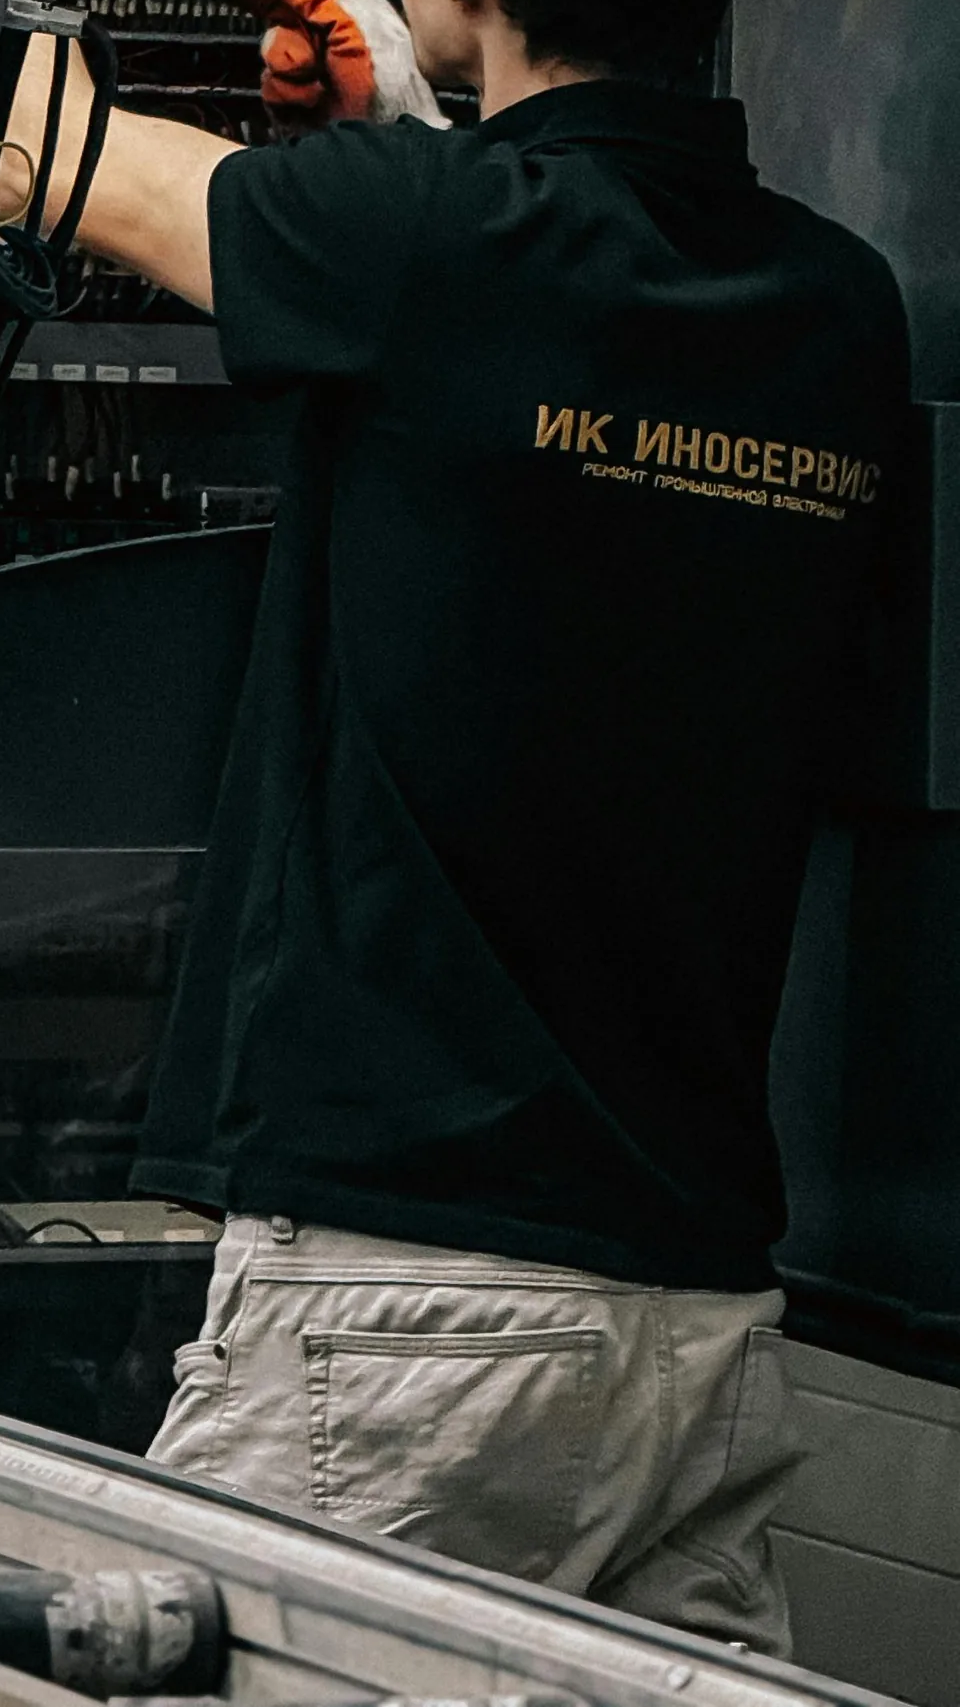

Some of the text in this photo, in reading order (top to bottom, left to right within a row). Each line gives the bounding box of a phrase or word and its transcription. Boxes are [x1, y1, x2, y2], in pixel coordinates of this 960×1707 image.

[534, 404, 881, 504] ИК ИНОСЕРВИС
[581, 462, 648, 484] РЕМОНТ
[654, 474, 767, 507] ПРОМЫШЛЕННОЙ
